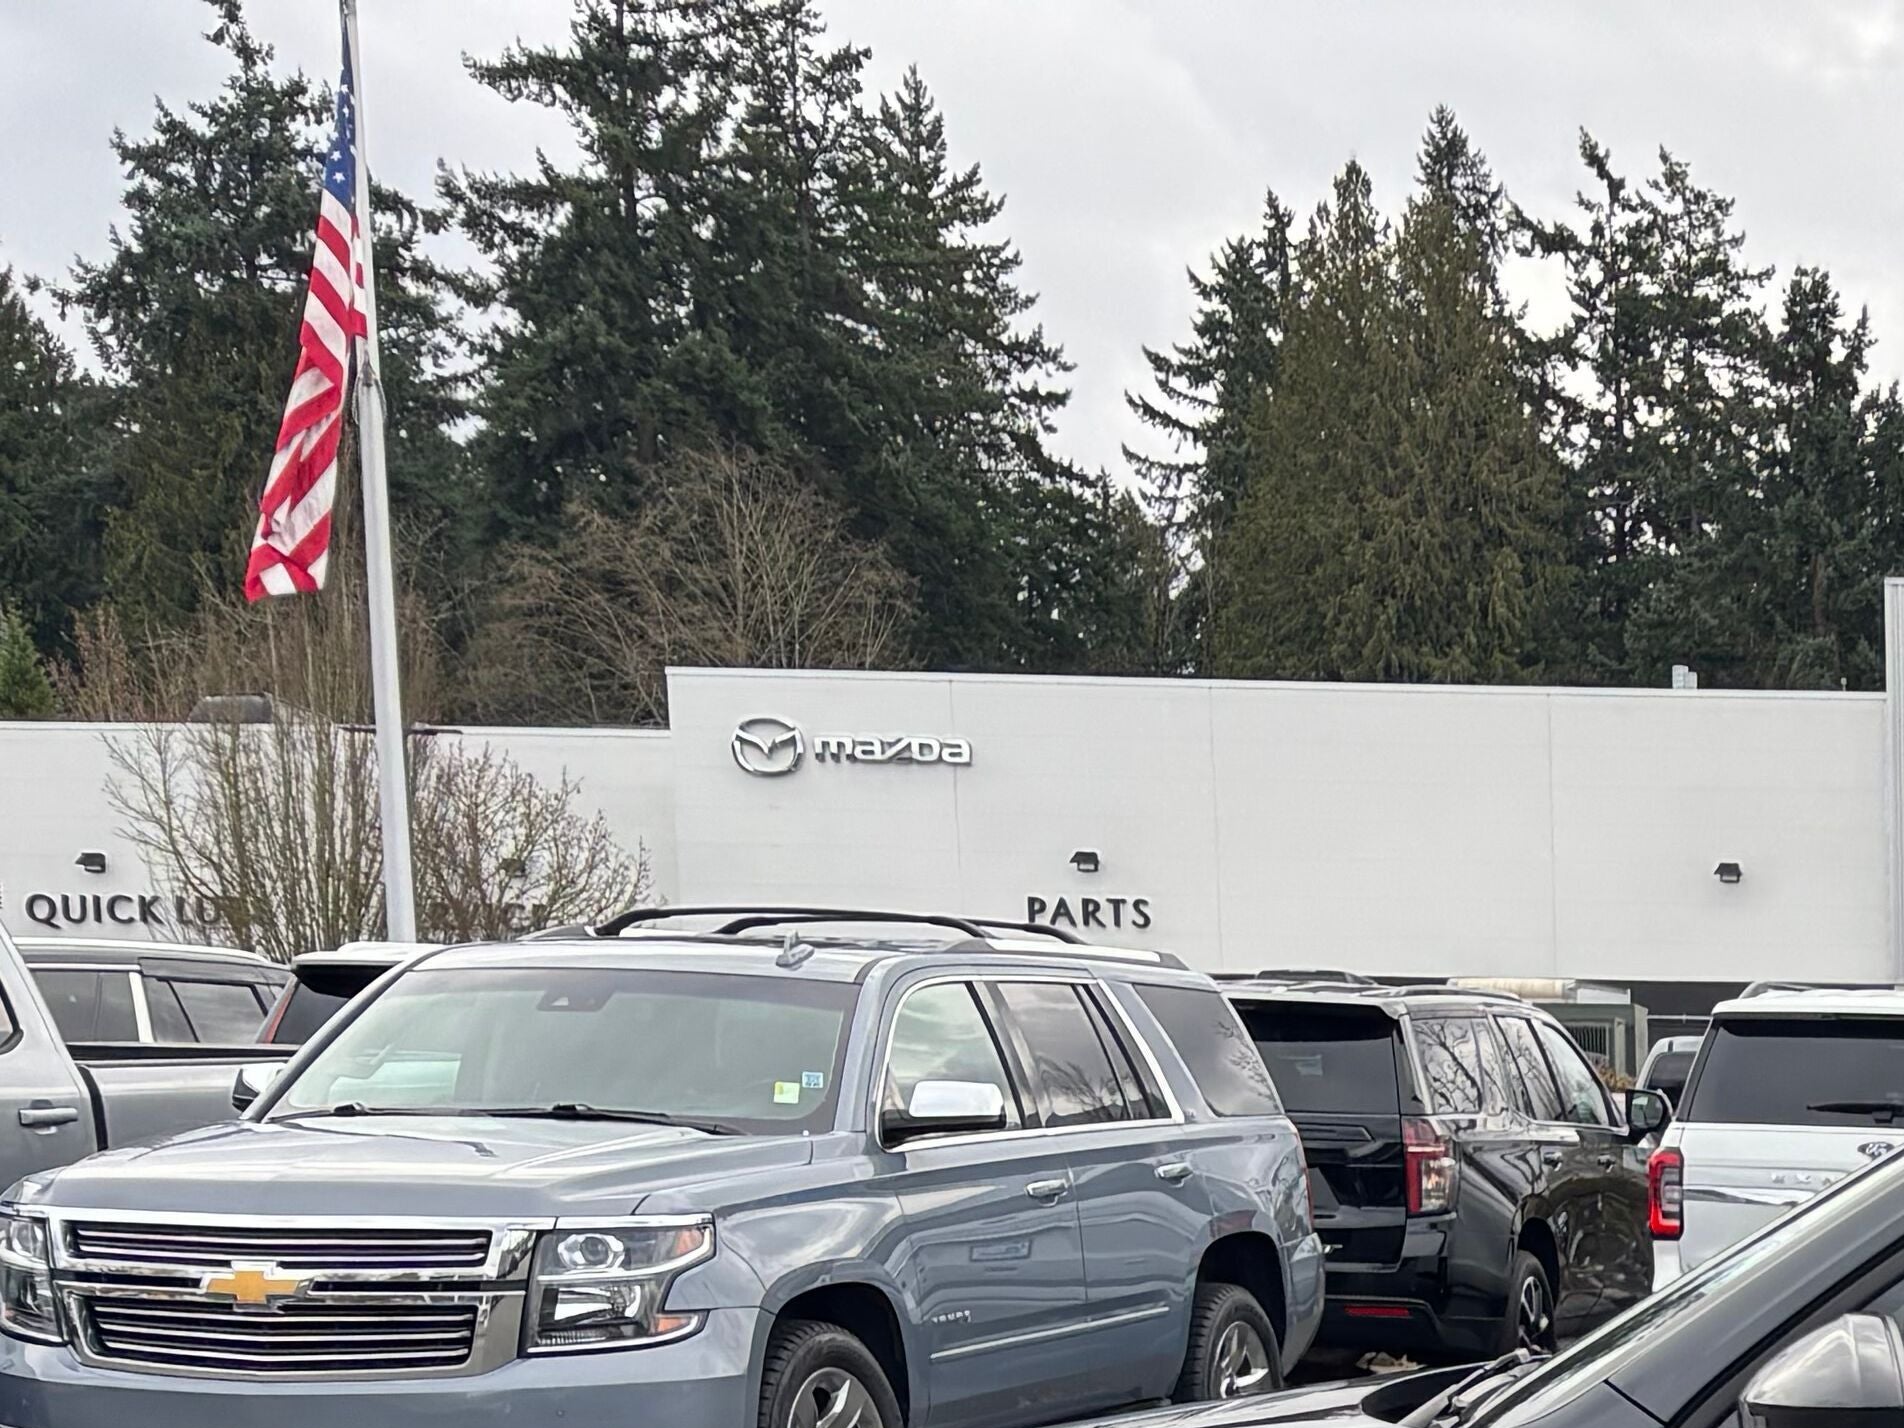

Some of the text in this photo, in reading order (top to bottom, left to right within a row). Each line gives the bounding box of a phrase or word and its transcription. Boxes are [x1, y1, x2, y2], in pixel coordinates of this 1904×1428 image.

[813, 735, 974, 767] mazda
[25, 894, 165, 930] QUICK
[1027, 896, 1152, 929] PARTS
